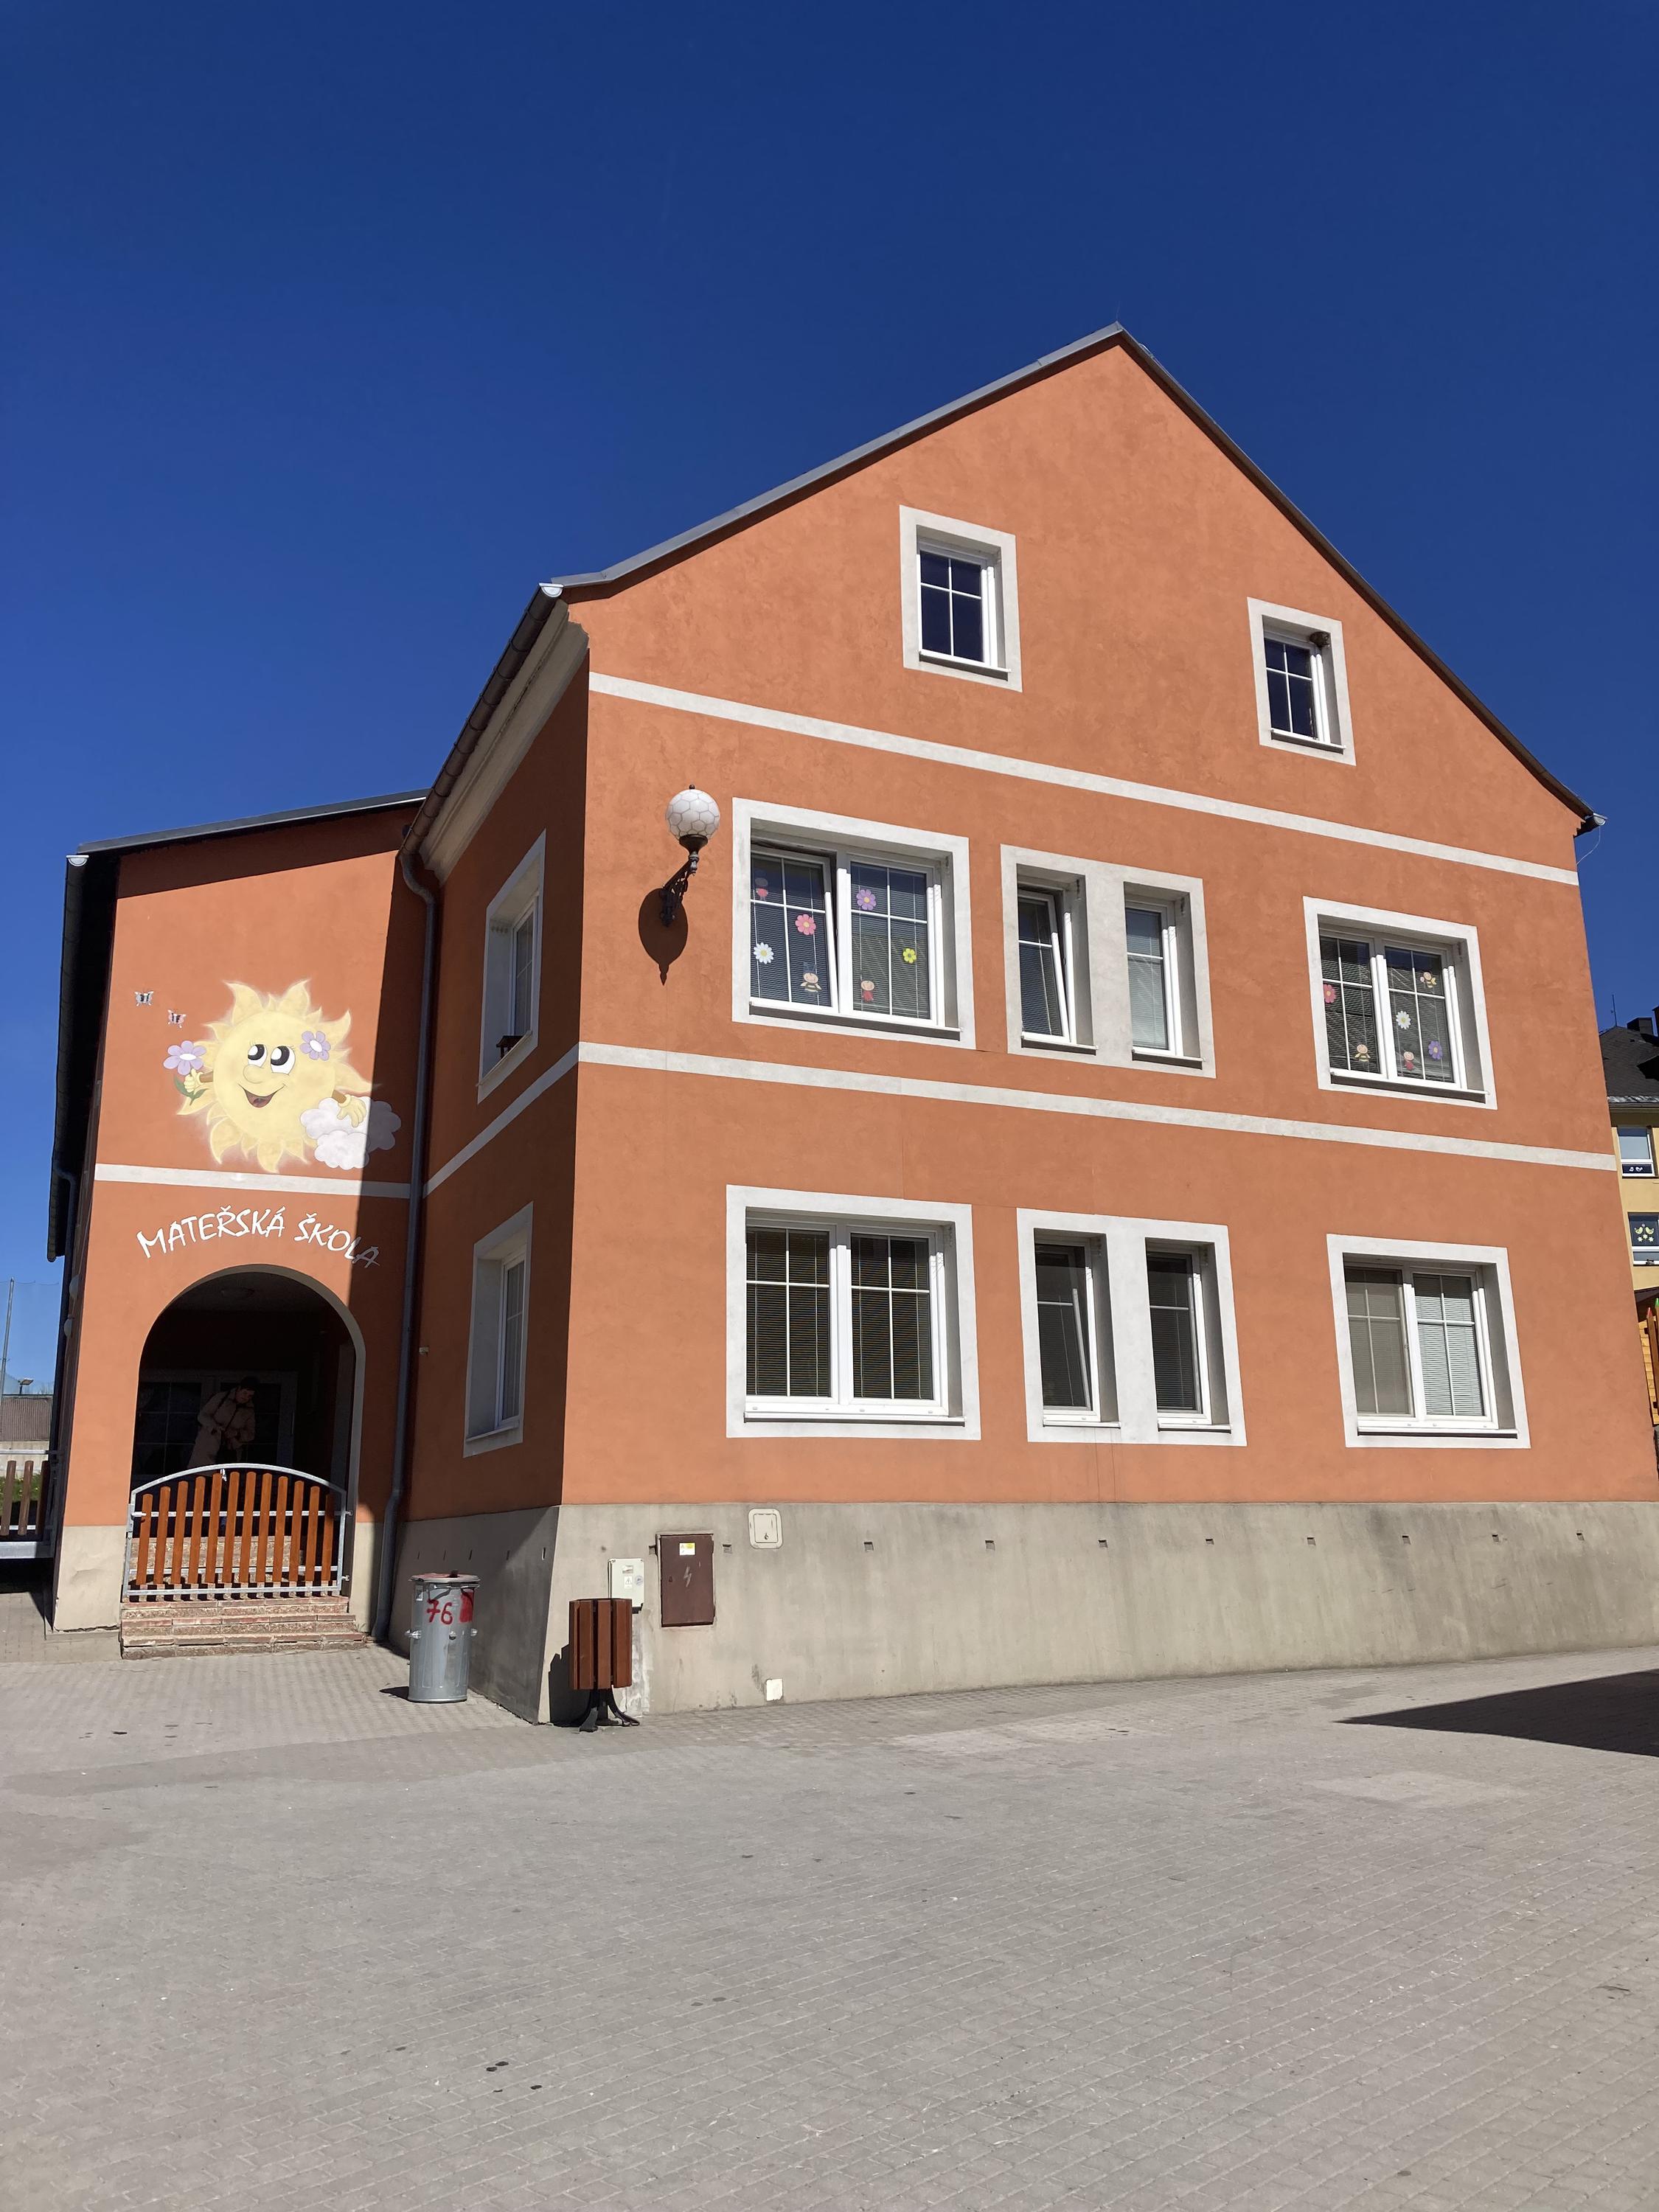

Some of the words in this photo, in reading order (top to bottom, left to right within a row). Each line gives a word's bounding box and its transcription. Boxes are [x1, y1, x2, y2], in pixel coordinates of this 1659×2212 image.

[136, 1205, 286, 1259] MATEŘSKÁ
[293, 1213, 380, 1268] ŠKOLA
[426, 1598, 453, 1625] 76
